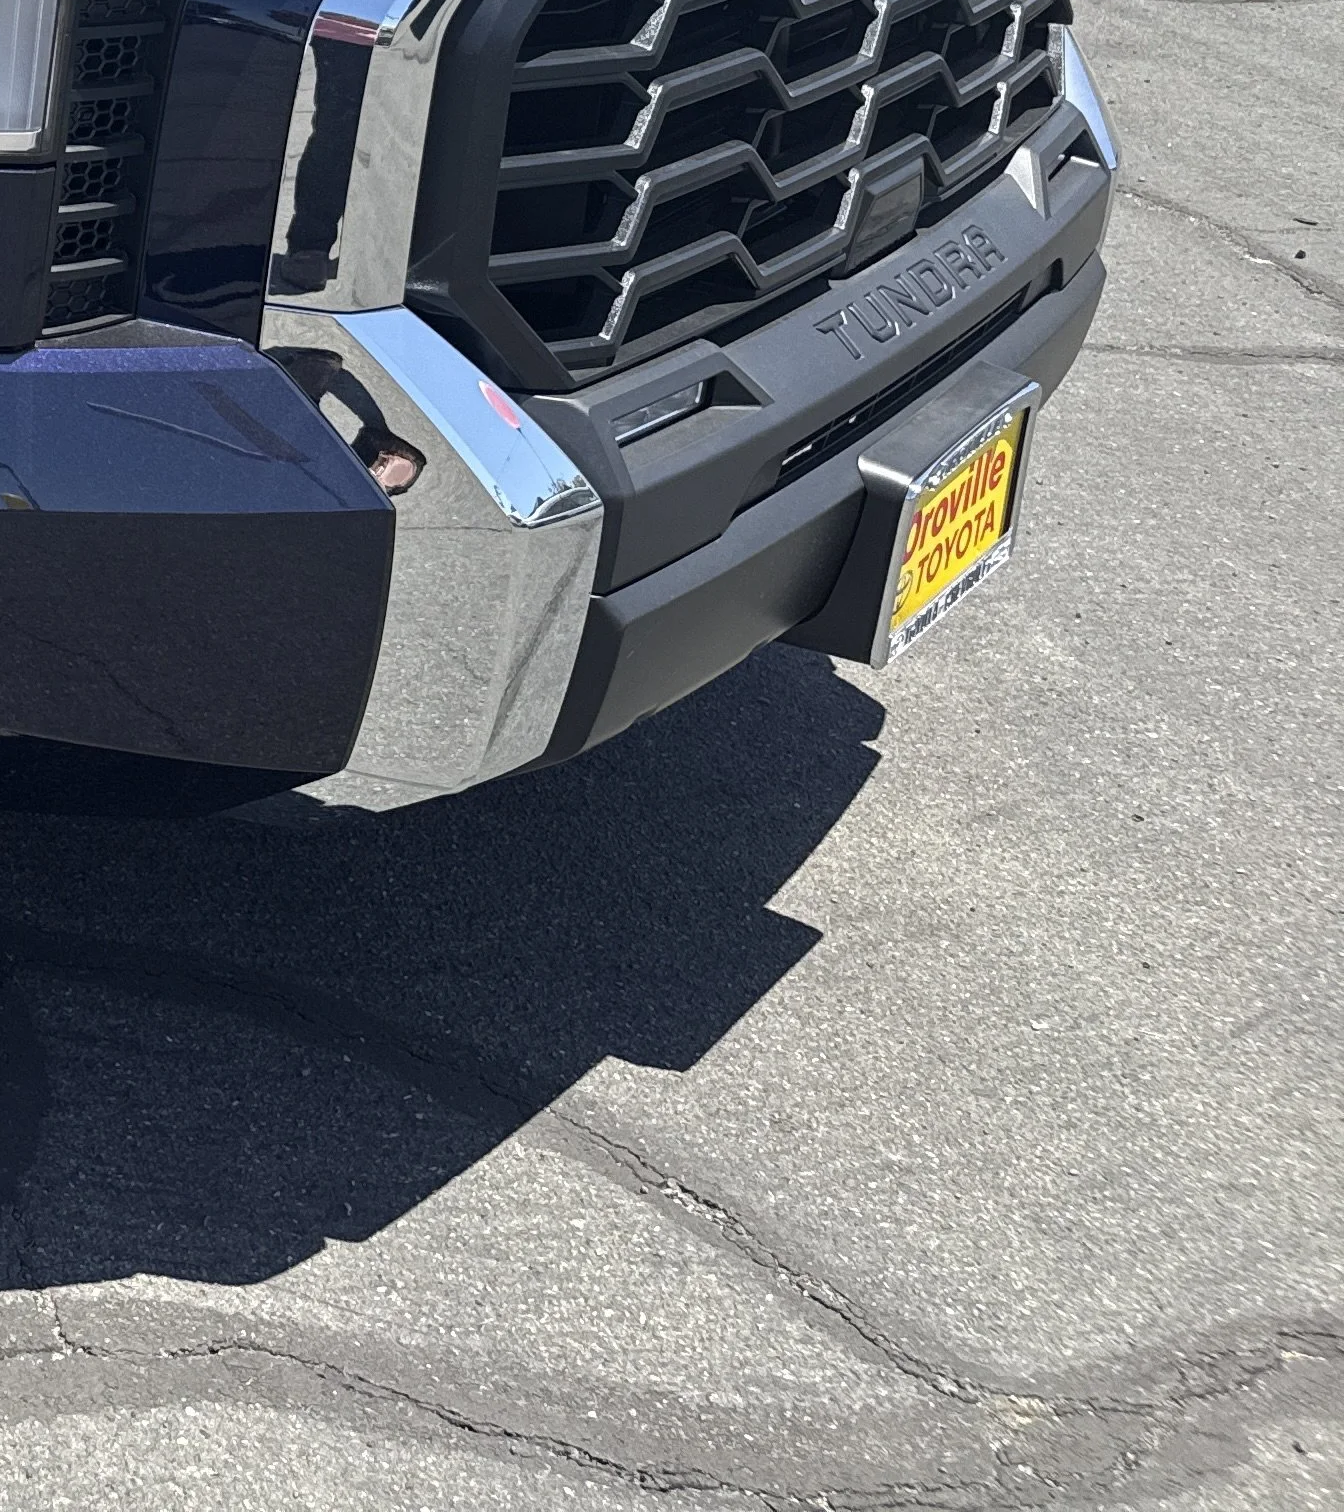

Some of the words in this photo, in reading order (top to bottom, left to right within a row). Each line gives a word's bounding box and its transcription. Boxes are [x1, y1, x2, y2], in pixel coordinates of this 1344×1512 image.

[815, 223, 1009, 361] TUNDRA
[901, 446, 1006, 566] Oroville
[915, 500, 995, 595] TOYOTA
